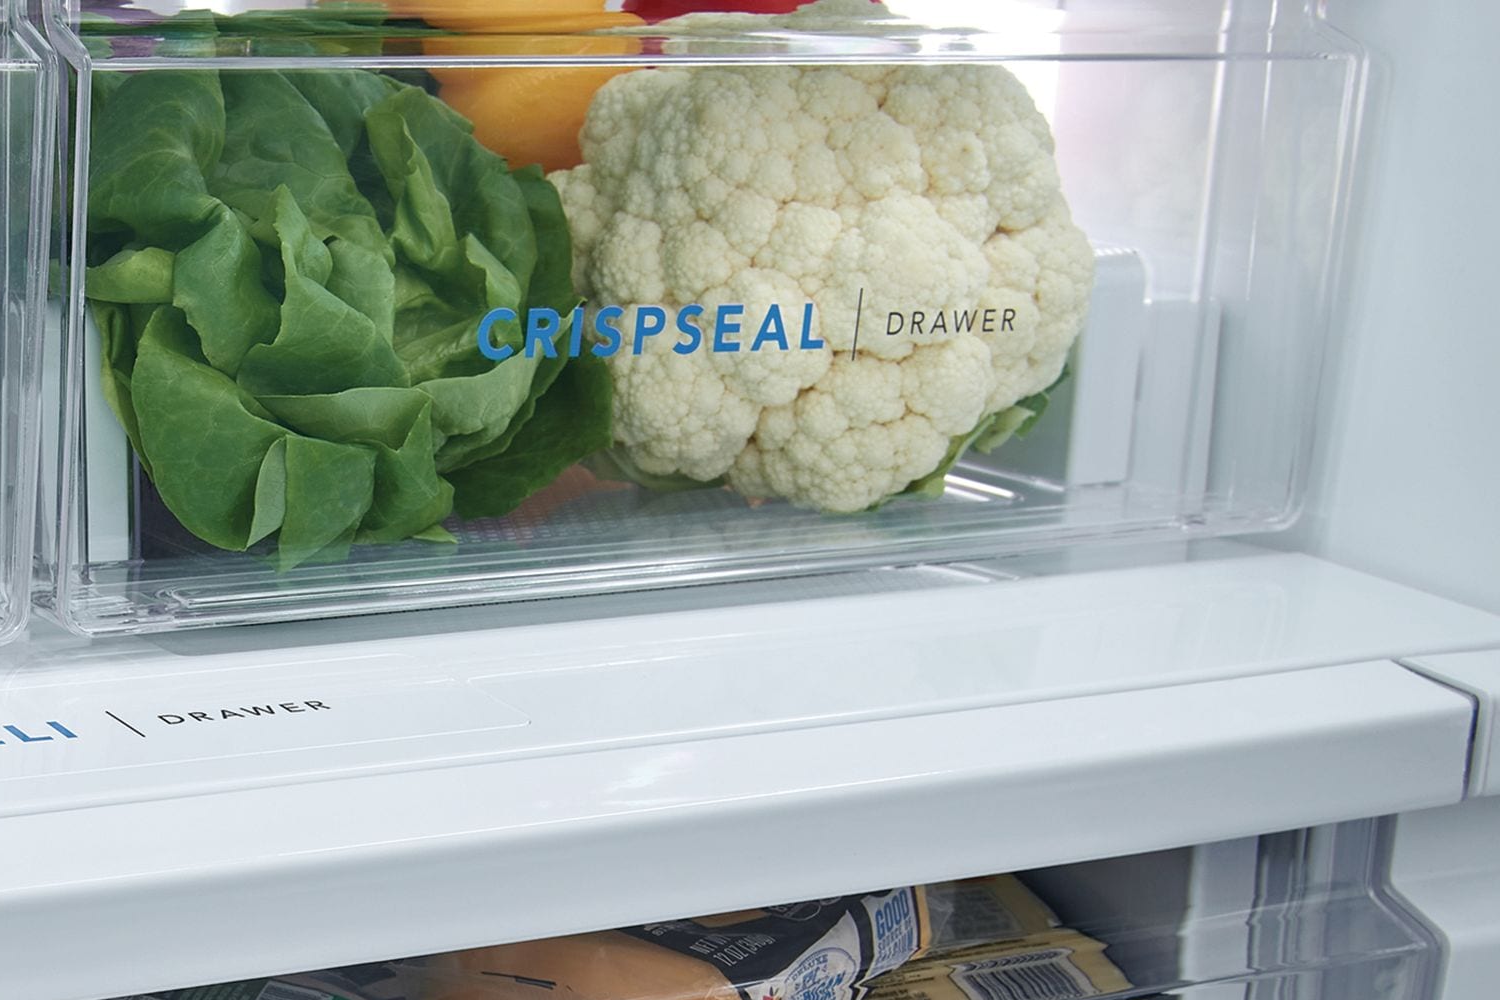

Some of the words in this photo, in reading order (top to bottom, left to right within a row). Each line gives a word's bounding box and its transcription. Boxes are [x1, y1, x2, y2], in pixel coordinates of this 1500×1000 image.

[477, 303, 825, 360] CRISPSEAL
[886, 308, 1017, 336] DRAWER
[157, 699, 332, 726] DRAWER
[875, 889, 910, 938] GOOD
